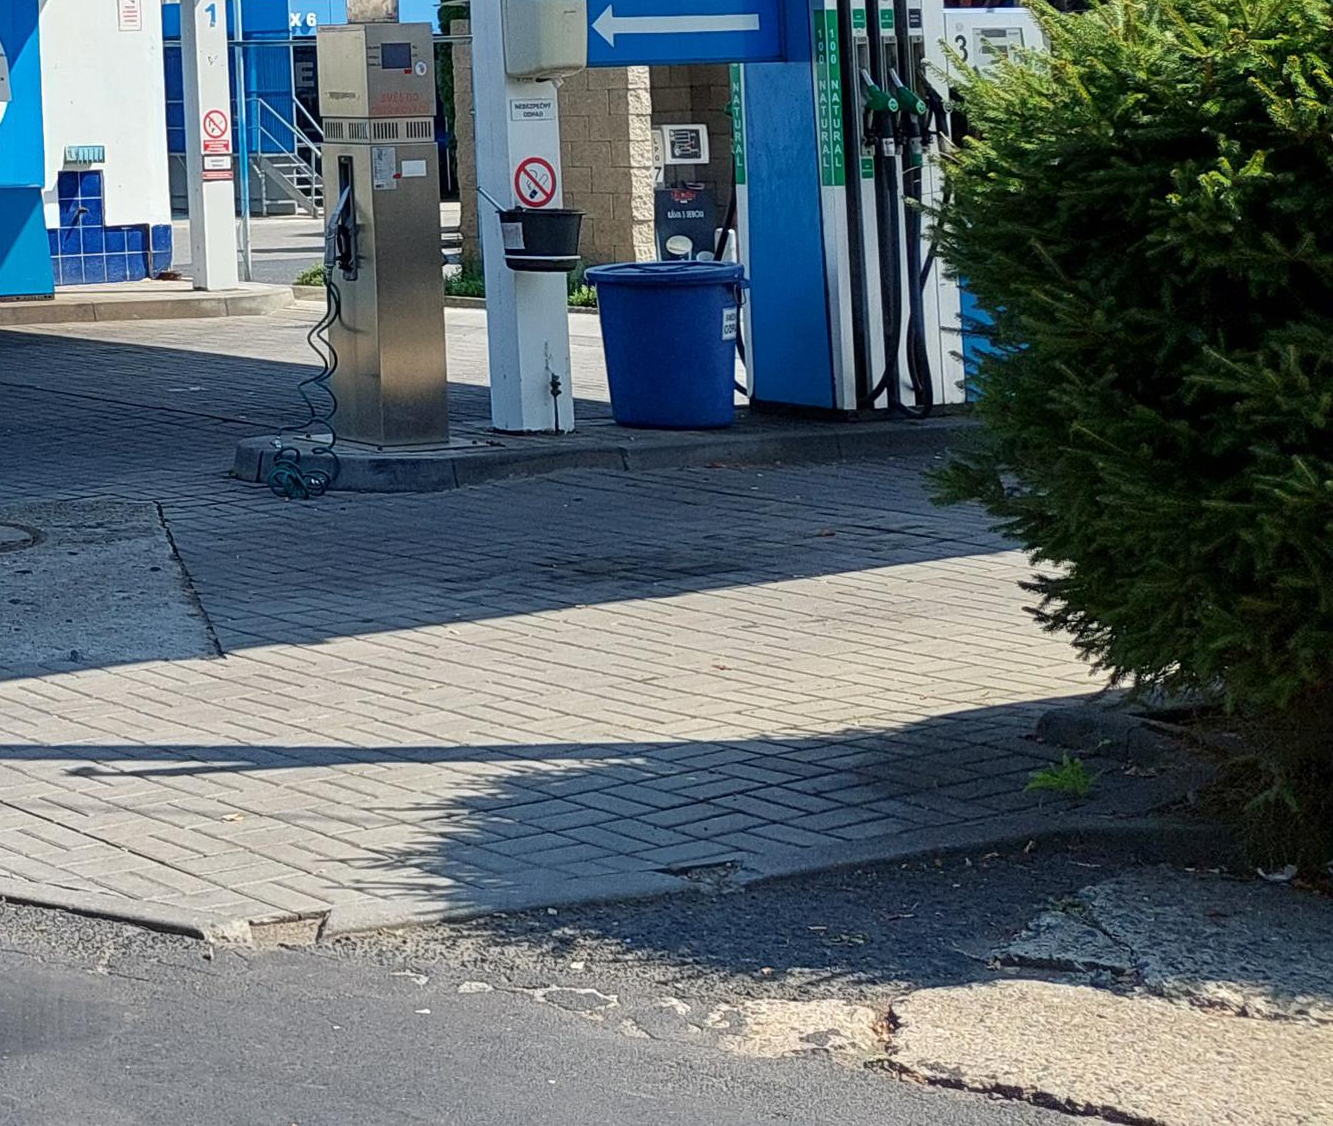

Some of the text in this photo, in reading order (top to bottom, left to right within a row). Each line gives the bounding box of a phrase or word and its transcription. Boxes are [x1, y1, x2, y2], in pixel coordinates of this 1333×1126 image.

[204, 2, 217, 27] 1
[306, 12, 317, 27] 6
[955, 35, 968, 62] 3
[831, 79, 843, 167] NATURAL
